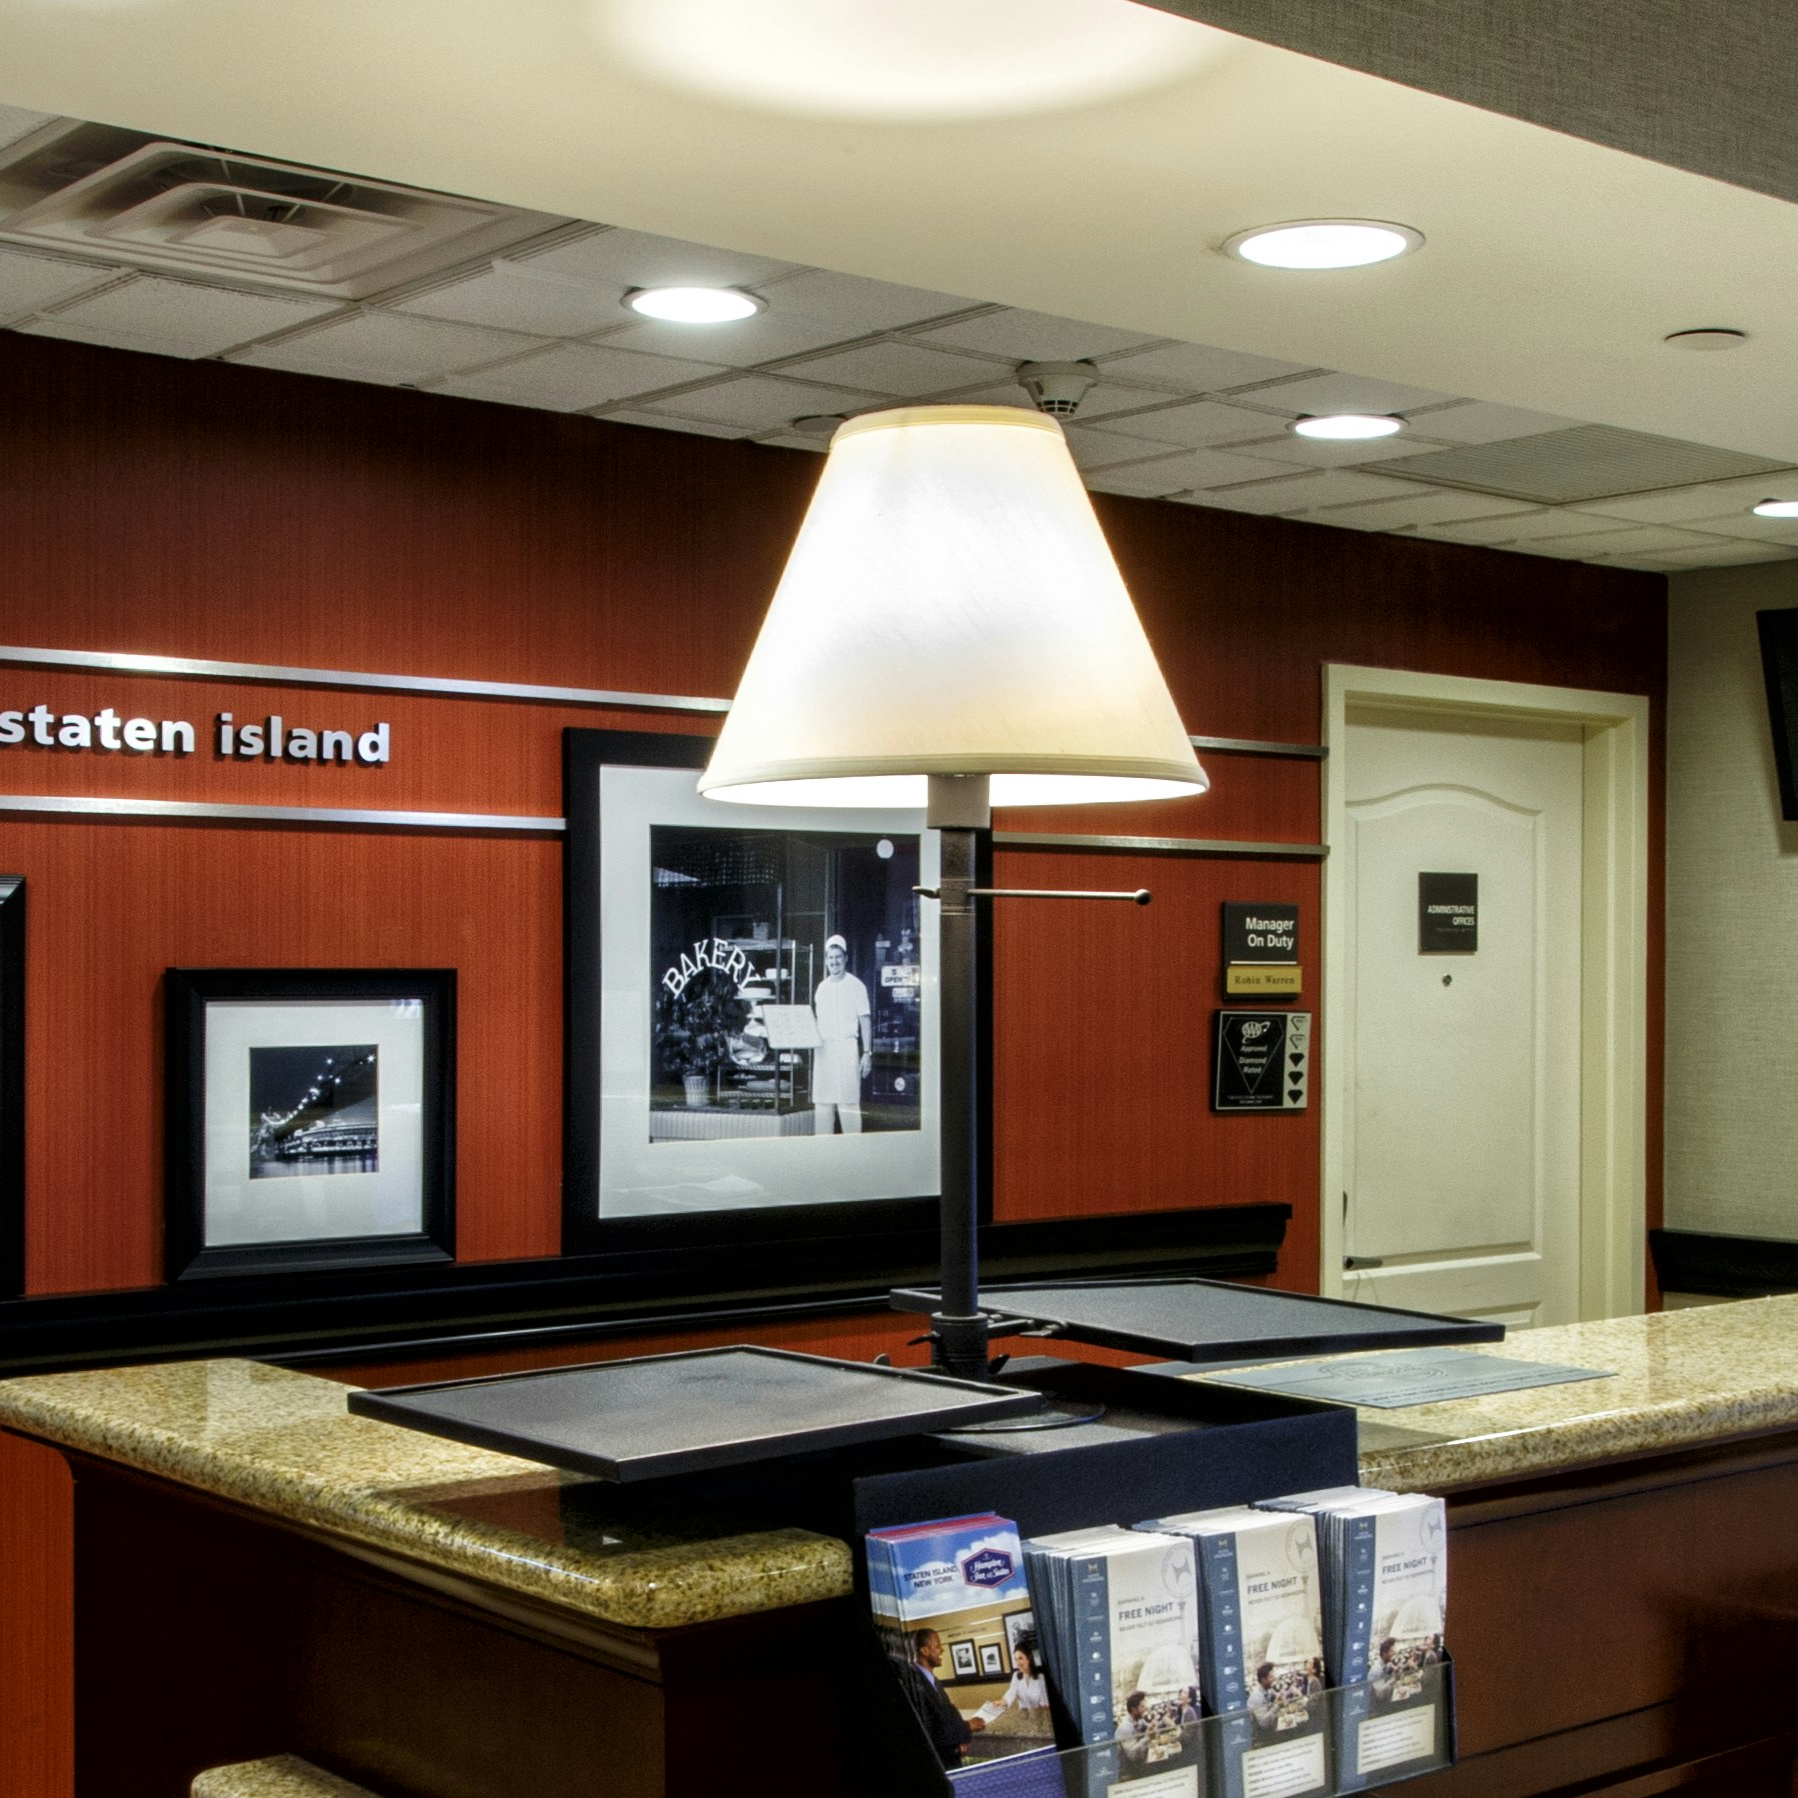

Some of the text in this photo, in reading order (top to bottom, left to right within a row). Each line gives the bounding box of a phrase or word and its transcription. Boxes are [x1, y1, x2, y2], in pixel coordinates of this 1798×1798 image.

[219, 711, 391, 763] island
[1245, 916, 1295, 934] Manager
[1452, 916, 1475, 926] OFFICES
[1247, 933, 1295, 951] On Duty
[662, 937, 762, 1000] BAKERY
[1234, 974, 1296, 985] Robin Warren
[1382, 1563, 1402, 1575] FREE
[1403, 1556, 1428, 1570] NIGHT
[903, 1570, 931, 1582] STATEN
[913, 1578, 933, 1589] NEW
[1247, 1576, 1298, 1595] FREE NIGHT
[1118, 1601, 1174, 1622] FREE NIGHT
